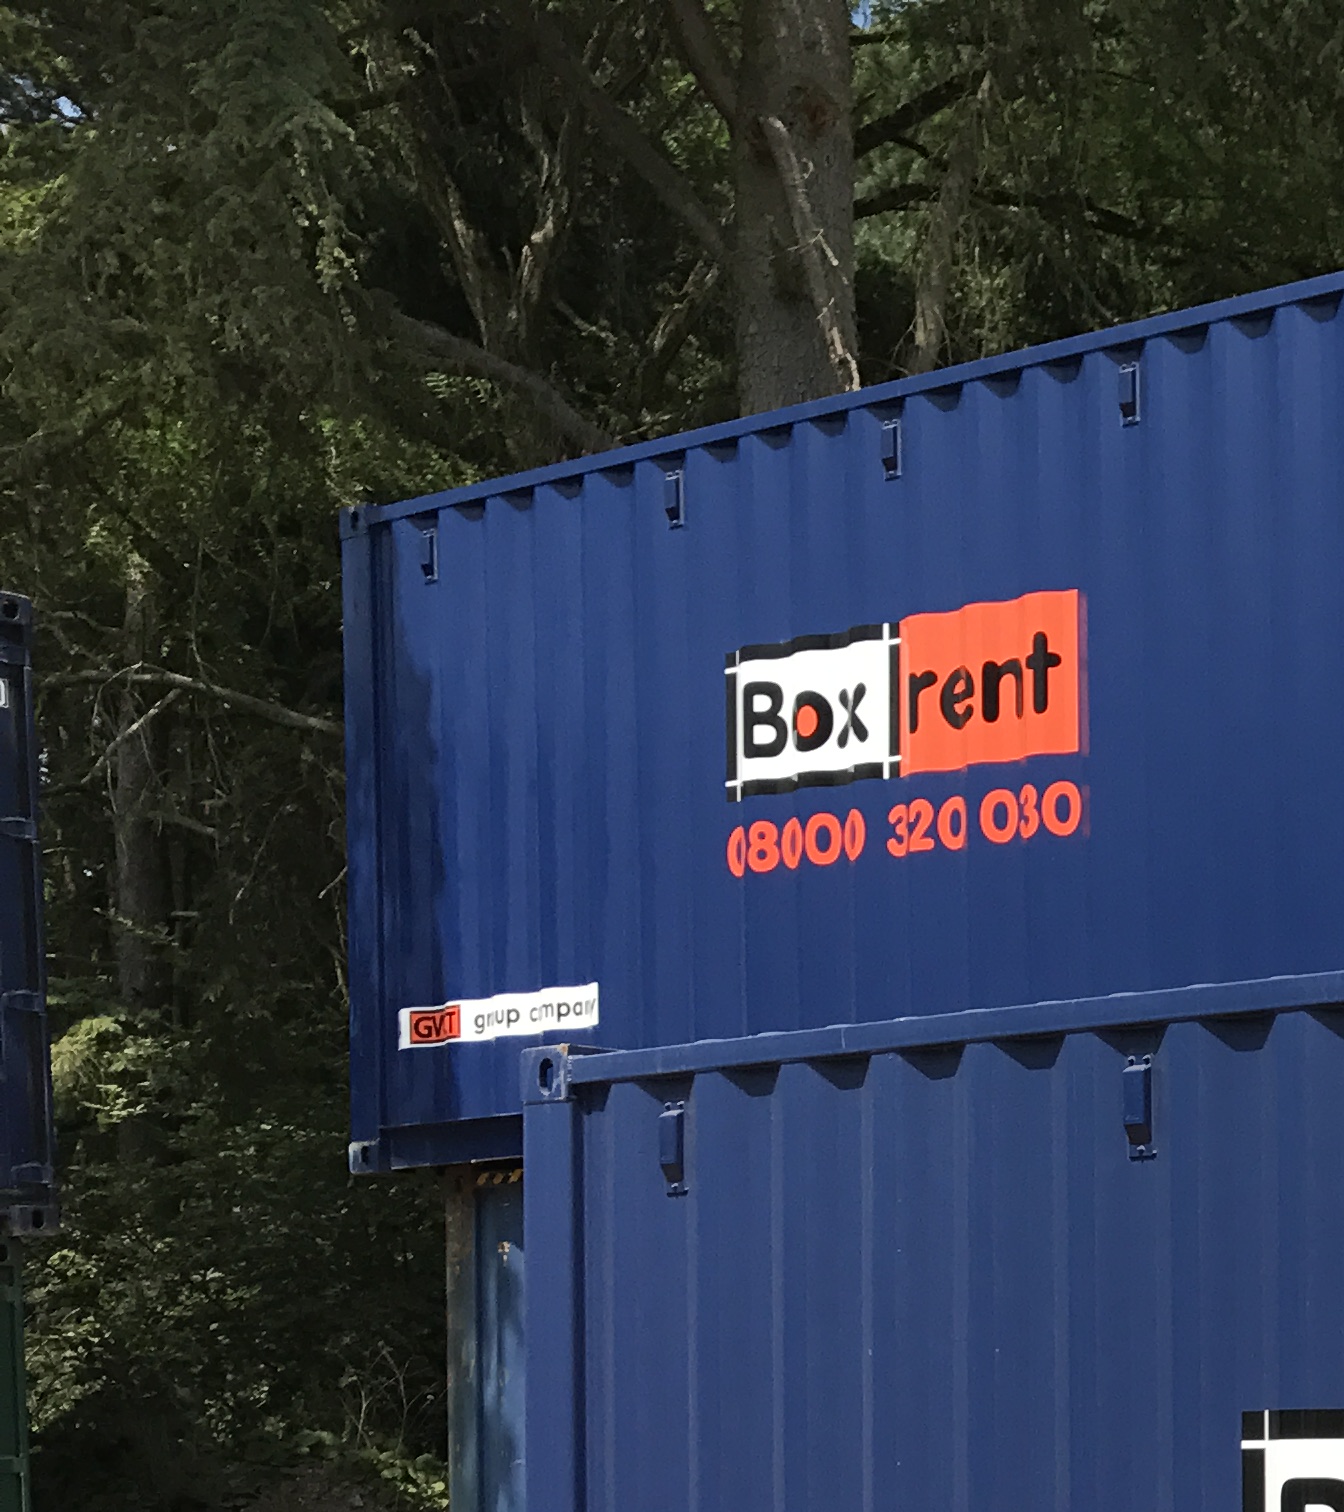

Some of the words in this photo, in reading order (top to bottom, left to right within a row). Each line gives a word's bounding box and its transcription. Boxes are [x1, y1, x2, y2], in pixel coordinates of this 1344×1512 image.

[742, 680, 868, 760] Box
[908, 631, 1062, 733] rent
[726, 808, 866, 878] 08000
[886, 795, 967, 858] 320
[979, 780, 1082, 844] 030
[414, 1011, 456, 1038] GVT
[474, 1008, 520, 1034] grup
